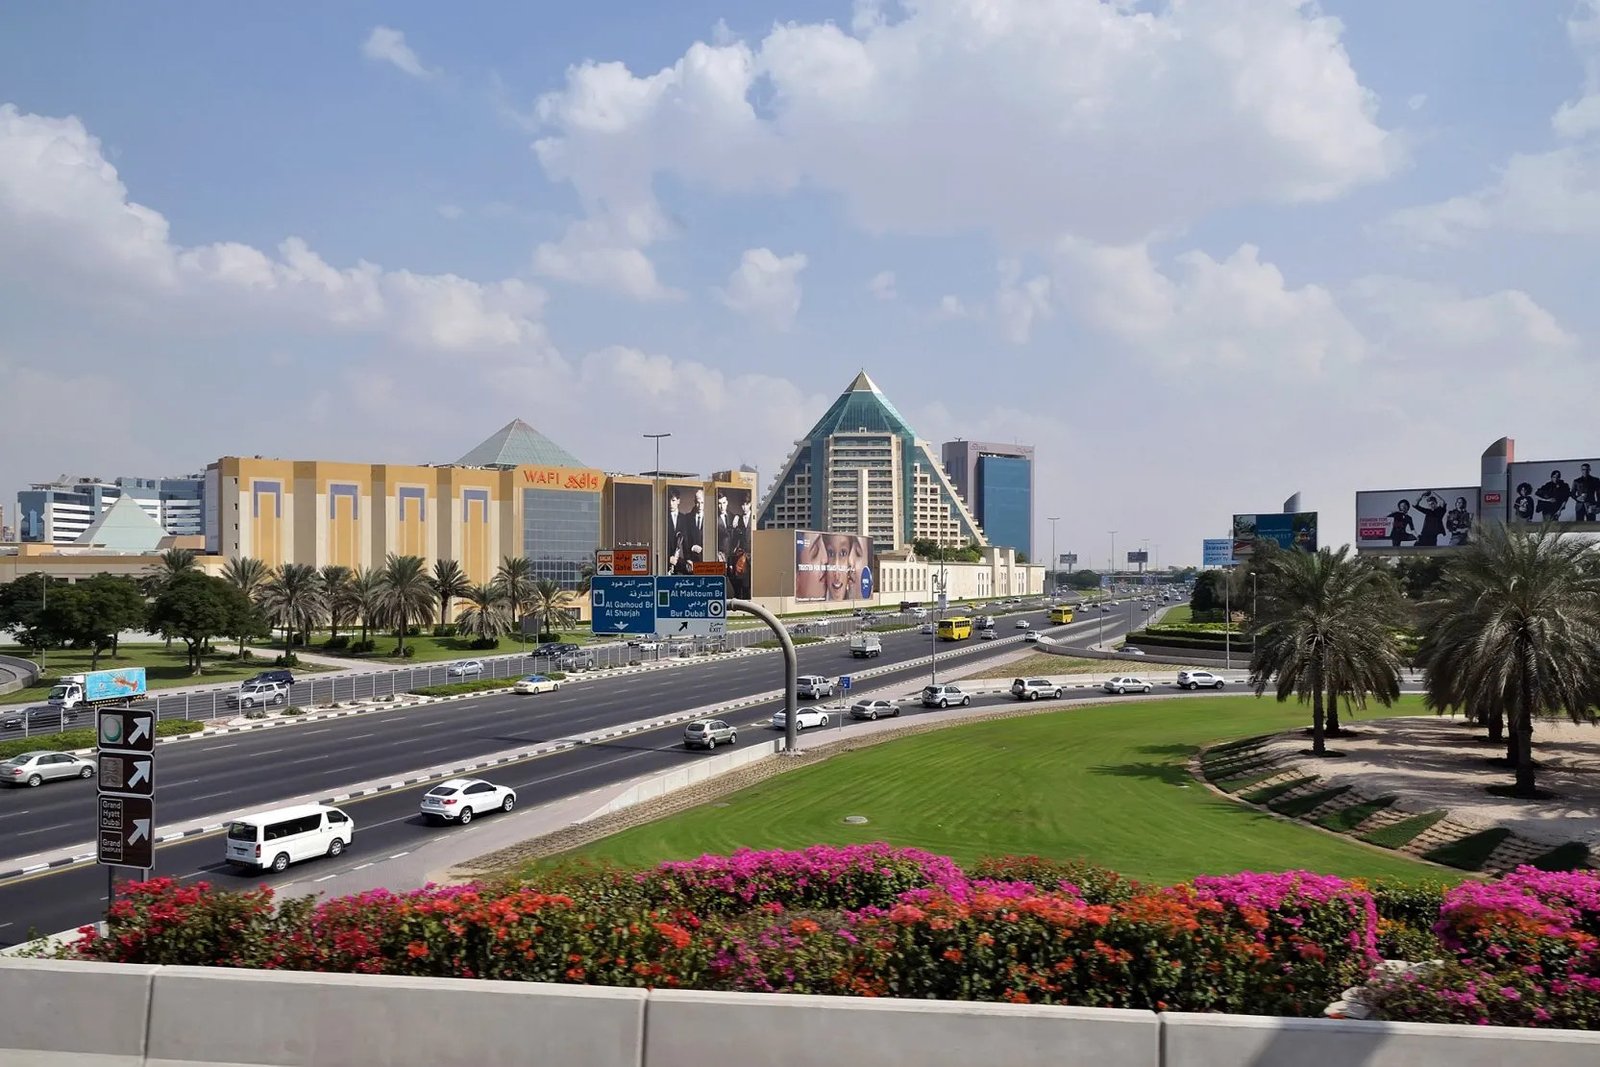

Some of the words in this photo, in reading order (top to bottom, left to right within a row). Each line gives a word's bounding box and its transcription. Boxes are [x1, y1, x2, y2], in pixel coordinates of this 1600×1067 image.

[523, 470, 560, 485] WAFI
[614, 600, 643, 609] Garhoud
[645, 601, 654, 609] Br
[614, 609, 640, 618] Sharjah
[685, 609, 706, 617] Dubai
[103, 801, 121, 809] Grand
[103, 809, 120, 818] Hyatt
[103, 818, 121, 826] Dubai
[103, 838, 121, 847] Grand
